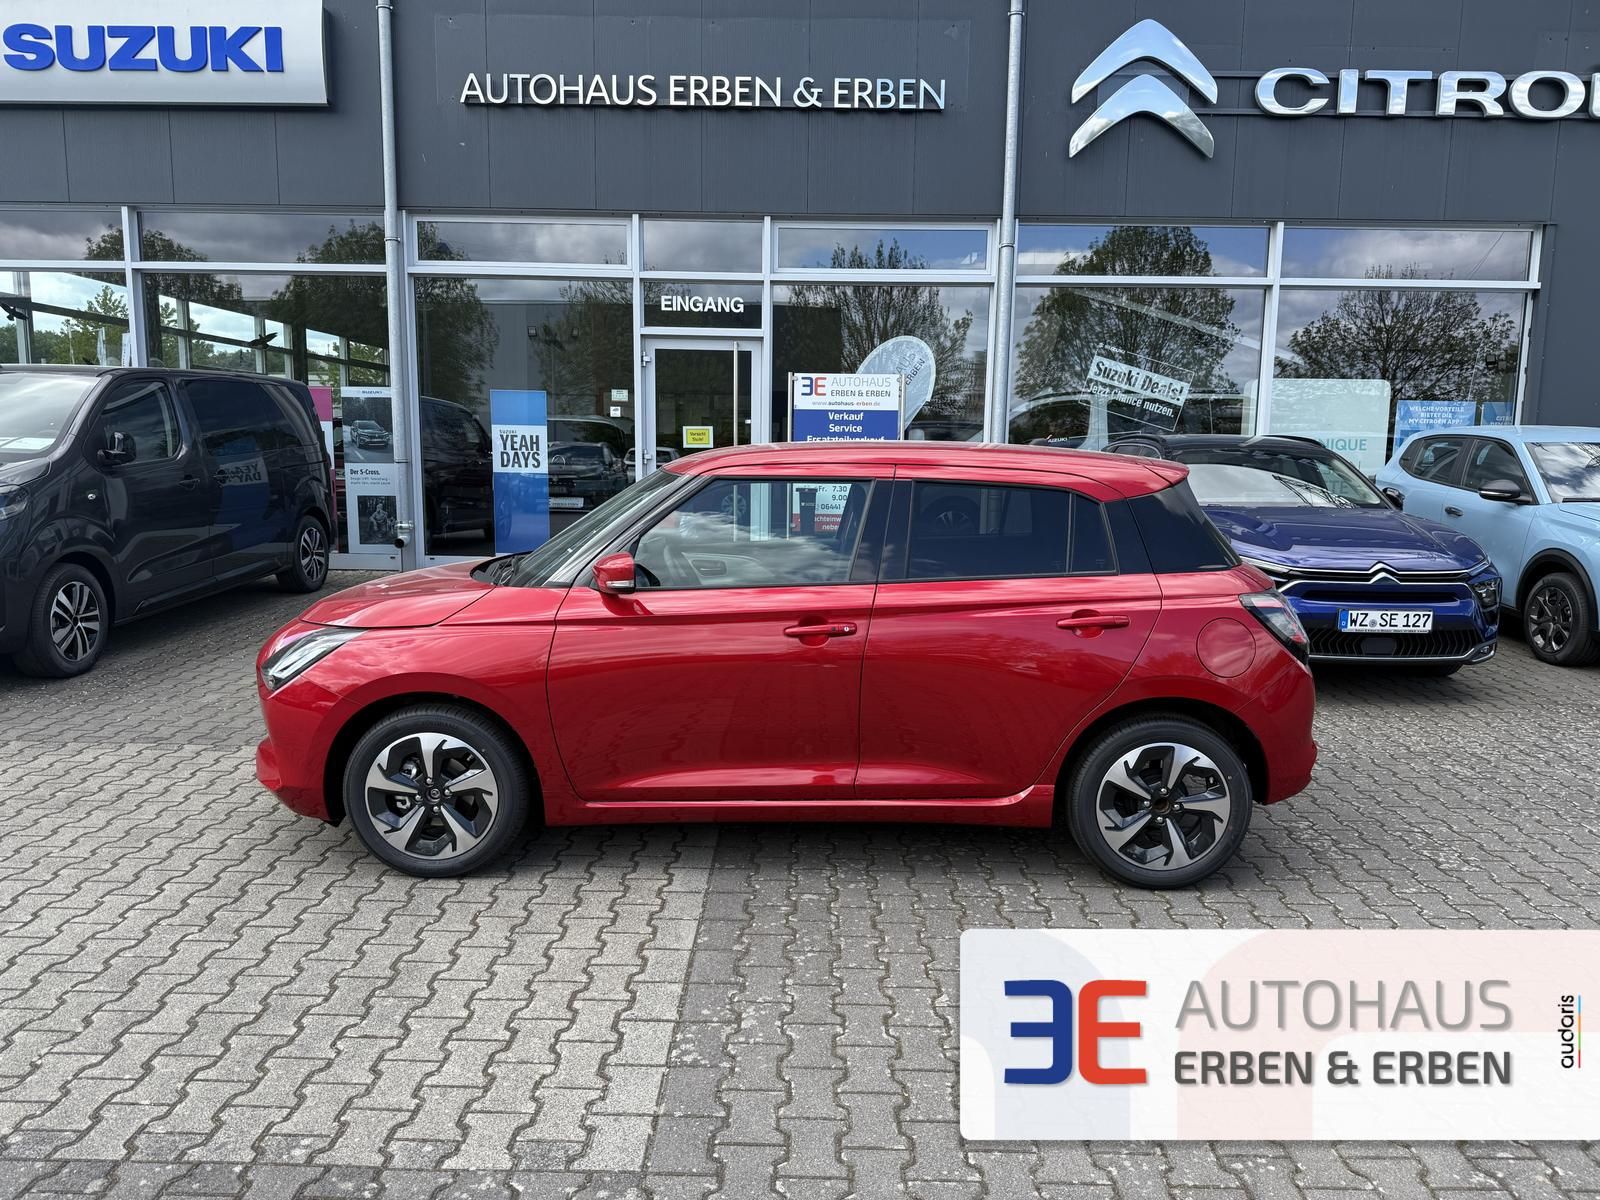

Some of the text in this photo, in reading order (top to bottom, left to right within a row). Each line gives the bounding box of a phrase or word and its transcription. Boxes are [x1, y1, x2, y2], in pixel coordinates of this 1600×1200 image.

[2, 23, 284, 72] SUZUKI
[460, 72, 947, 111] AUTOHAUS ERBEN & ERBEN
[1255, 66, 1600, 121] CITRO
[660, 295, 745, 313] EINGANG
[830, 376, 892, 388] AUTOHAUS
[1094, 360, 1185, 402] Suzuki Deals!
[830, 389, 857, 397] ERBEN
[857, 389, 865, 397] &
[1110, 389, 1143, 408] Chance
[1142, 400, 1175, 418] nutzen.
[828, 411, 864, 421] Verkauf
[828, 424, 863, 433] Service
[499, 434, 540, 451] YEAH
[500, 451, 541, 469] DAYS
[832, 485, 848, 493] 7.30
[820, 503, 841, 511] 06441
[1349, 612, 1431, 628] WZ SE 127
